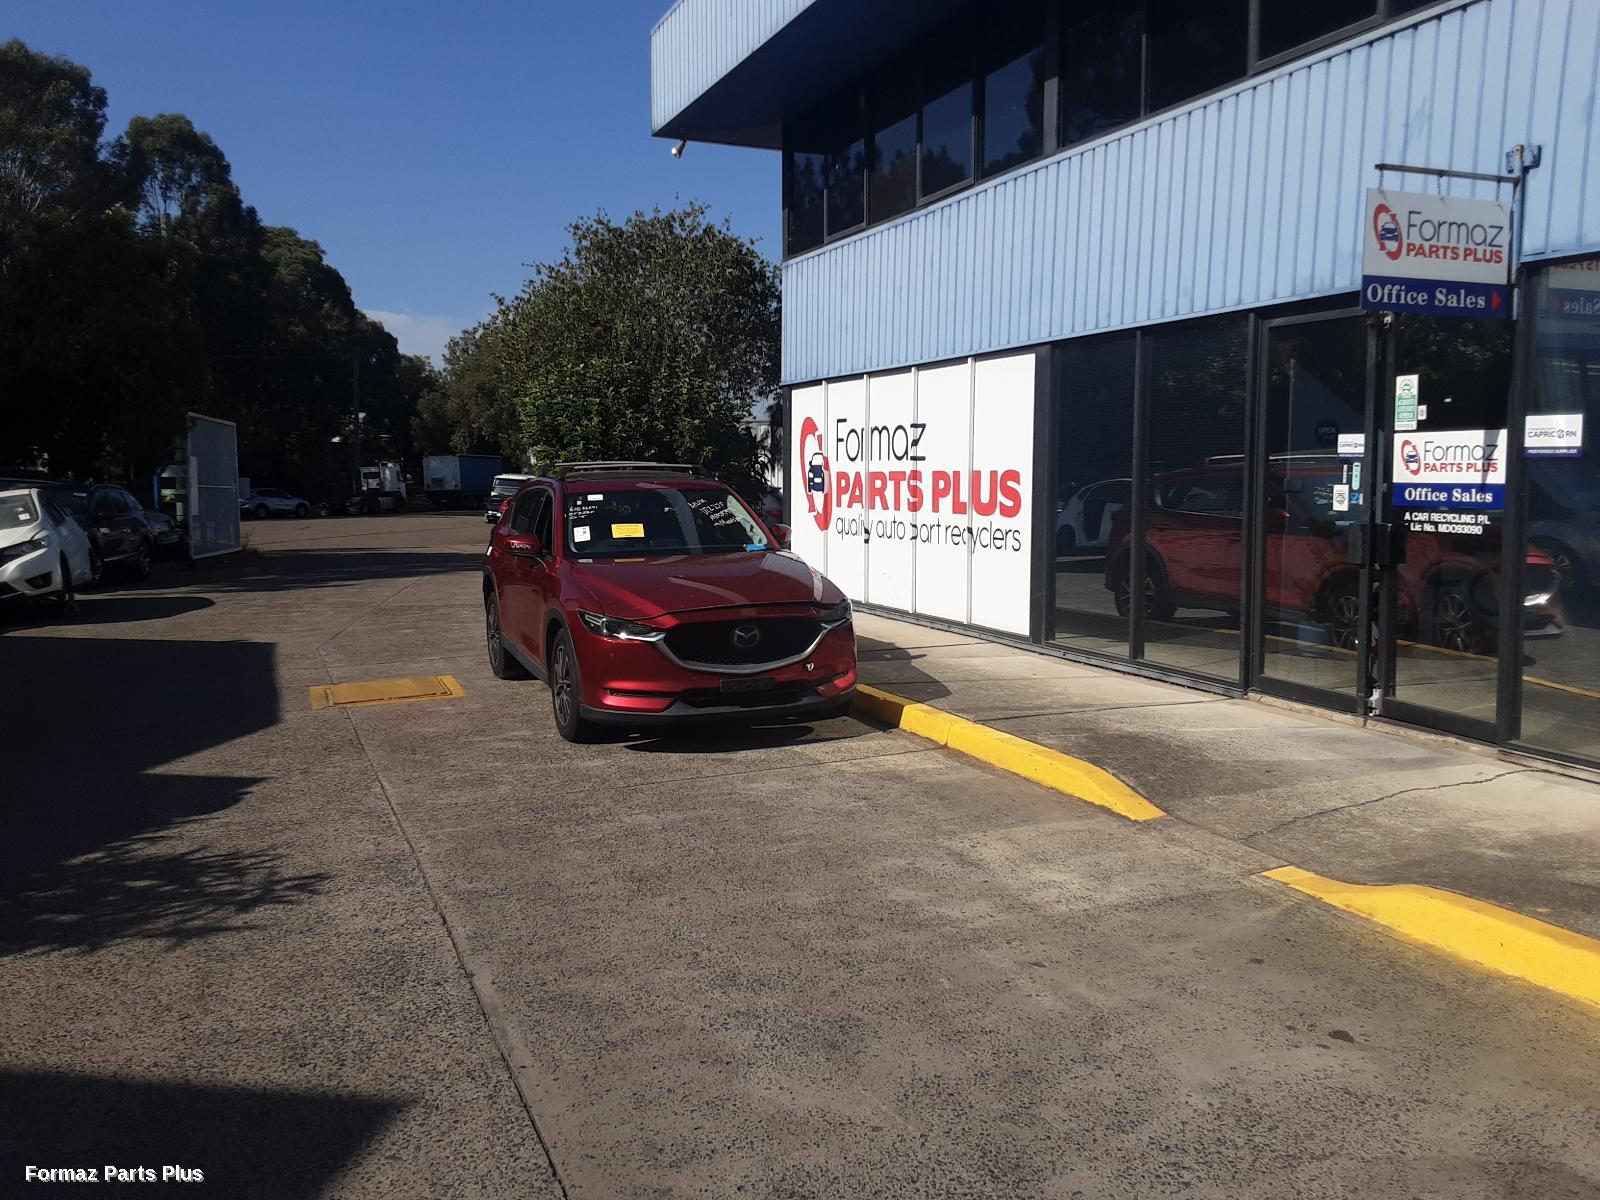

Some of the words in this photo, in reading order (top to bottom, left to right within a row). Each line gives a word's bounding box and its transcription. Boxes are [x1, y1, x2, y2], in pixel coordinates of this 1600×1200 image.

[1406, 210, 1504, 249] Formaz
[1406, 242, 1460, 261] PARTS
[1463, 247, 1504, 265] PLUS
[1366, 283, 1428, 306] Office
[1434, 287, 1486, 309] Sales
[836, 418, 927, 462] Formaz
[1423, 440, 1499, 462] Formaz
[1423, 462, 1464, 473] PARTS
[1466, 462, 1499, 473] PLUS
[835, 470, 924, 513] PARTS
[931, 469, 1022, 519] PLUS
[1404, 487, 1448, 502] Office
[1451, 488, 1493, 503] Sales
[1404, 511, 1411, 521] A
[1412, 512, 1429, 522] CAR
[1430, 513, 1476, 524] RECYCLING
[1410, 522, 1422, 531] Lic
[836, 513, 874, 544] qualiy
[876, 514, 906, 540] auto
[945, 520, 1022, 555] recyclers
